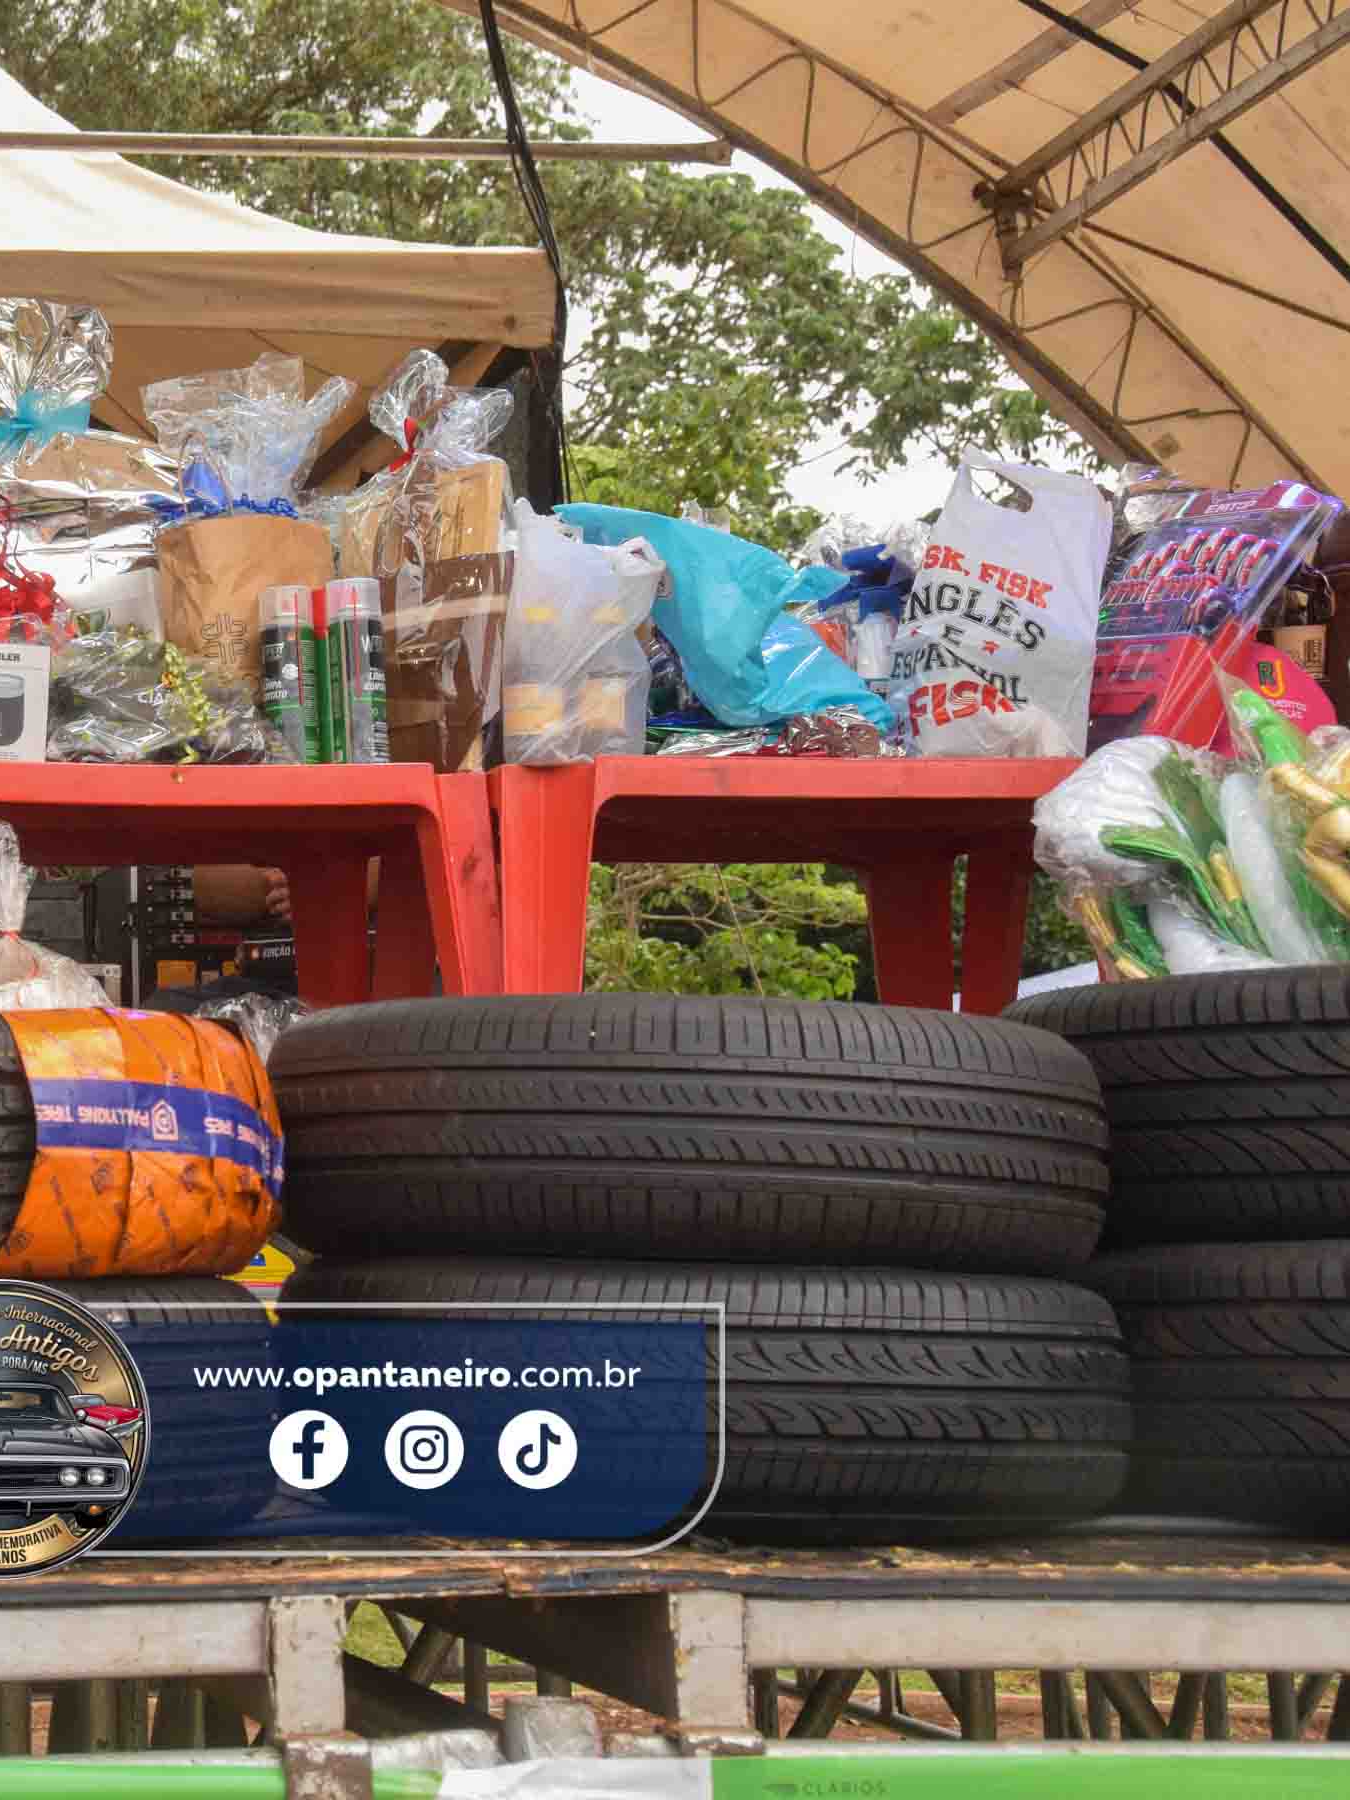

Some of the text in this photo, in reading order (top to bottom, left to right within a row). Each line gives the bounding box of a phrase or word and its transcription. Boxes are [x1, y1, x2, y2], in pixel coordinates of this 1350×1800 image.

[922, 544, 1054, 609] SK, FISK
[941, 622, 965, 648] E
[907, 680, 1018, 737] FISK
[801, 1779, 887, 1797] CLARIOS
